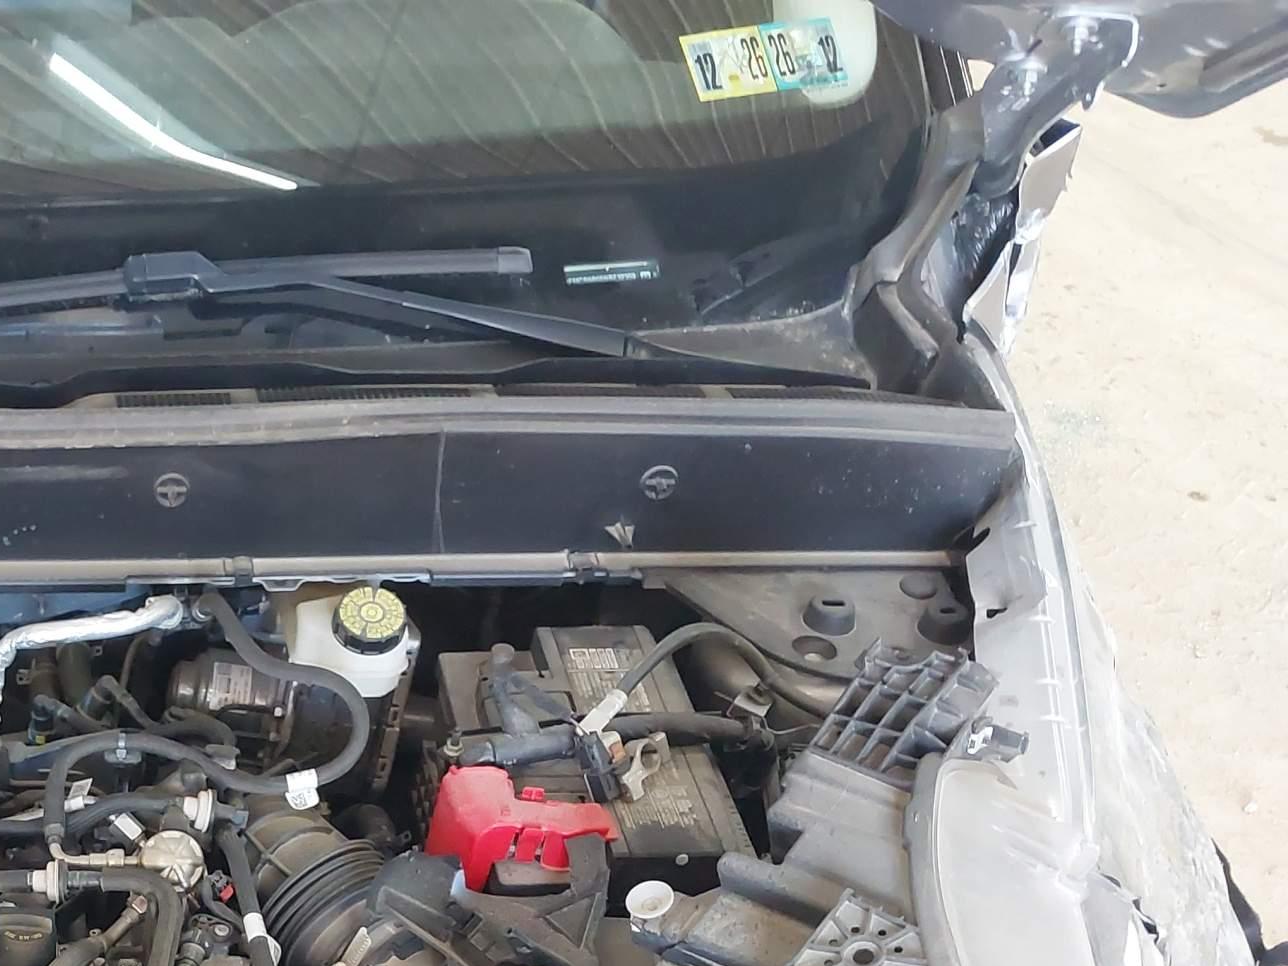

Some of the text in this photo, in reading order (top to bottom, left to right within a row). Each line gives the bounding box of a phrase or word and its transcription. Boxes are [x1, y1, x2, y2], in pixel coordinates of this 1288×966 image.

[694, 36, 768, 91] 12 26
[768, 33, 844, 77] 26 12
